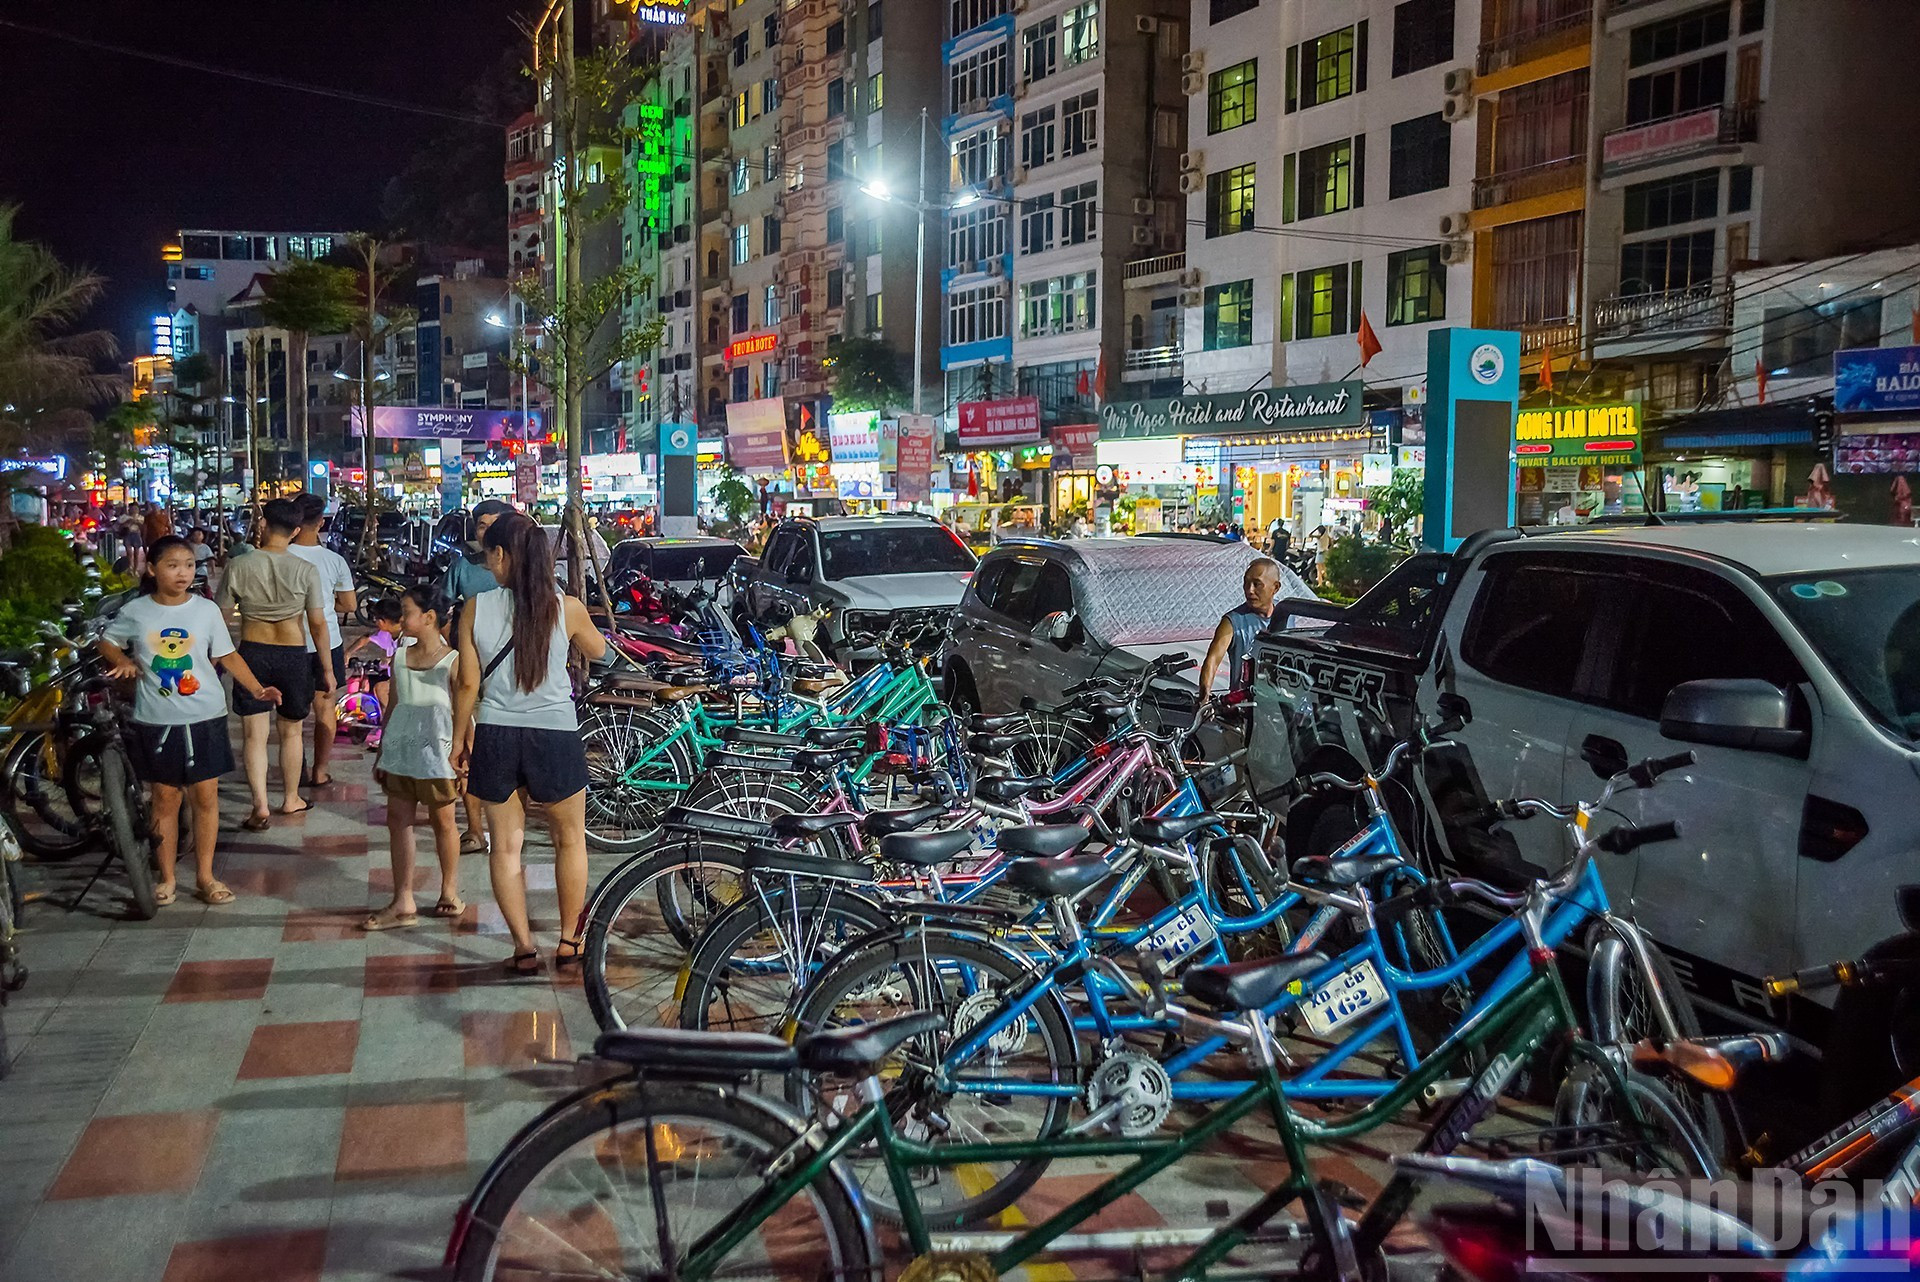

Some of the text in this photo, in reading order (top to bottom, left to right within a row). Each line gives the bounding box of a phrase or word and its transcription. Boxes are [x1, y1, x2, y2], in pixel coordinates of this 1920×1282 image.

[417, 413, 473, 423] SYMPHONY
[1169, 399, 1213, 426] Hotel
[1215, 399, 1246, 423] and
[1249, 388, 1349, 425] Restaurant
[1588, 406, 1638, 437] HOTEL
[1516, 454, 1632, 467] RIVATE BALCONY HOTEL
[1258, 648, 1387, 723] RANGER
[1161, 929, 1201, 964] 161
[1323, 989, 1373, 1025] 162
